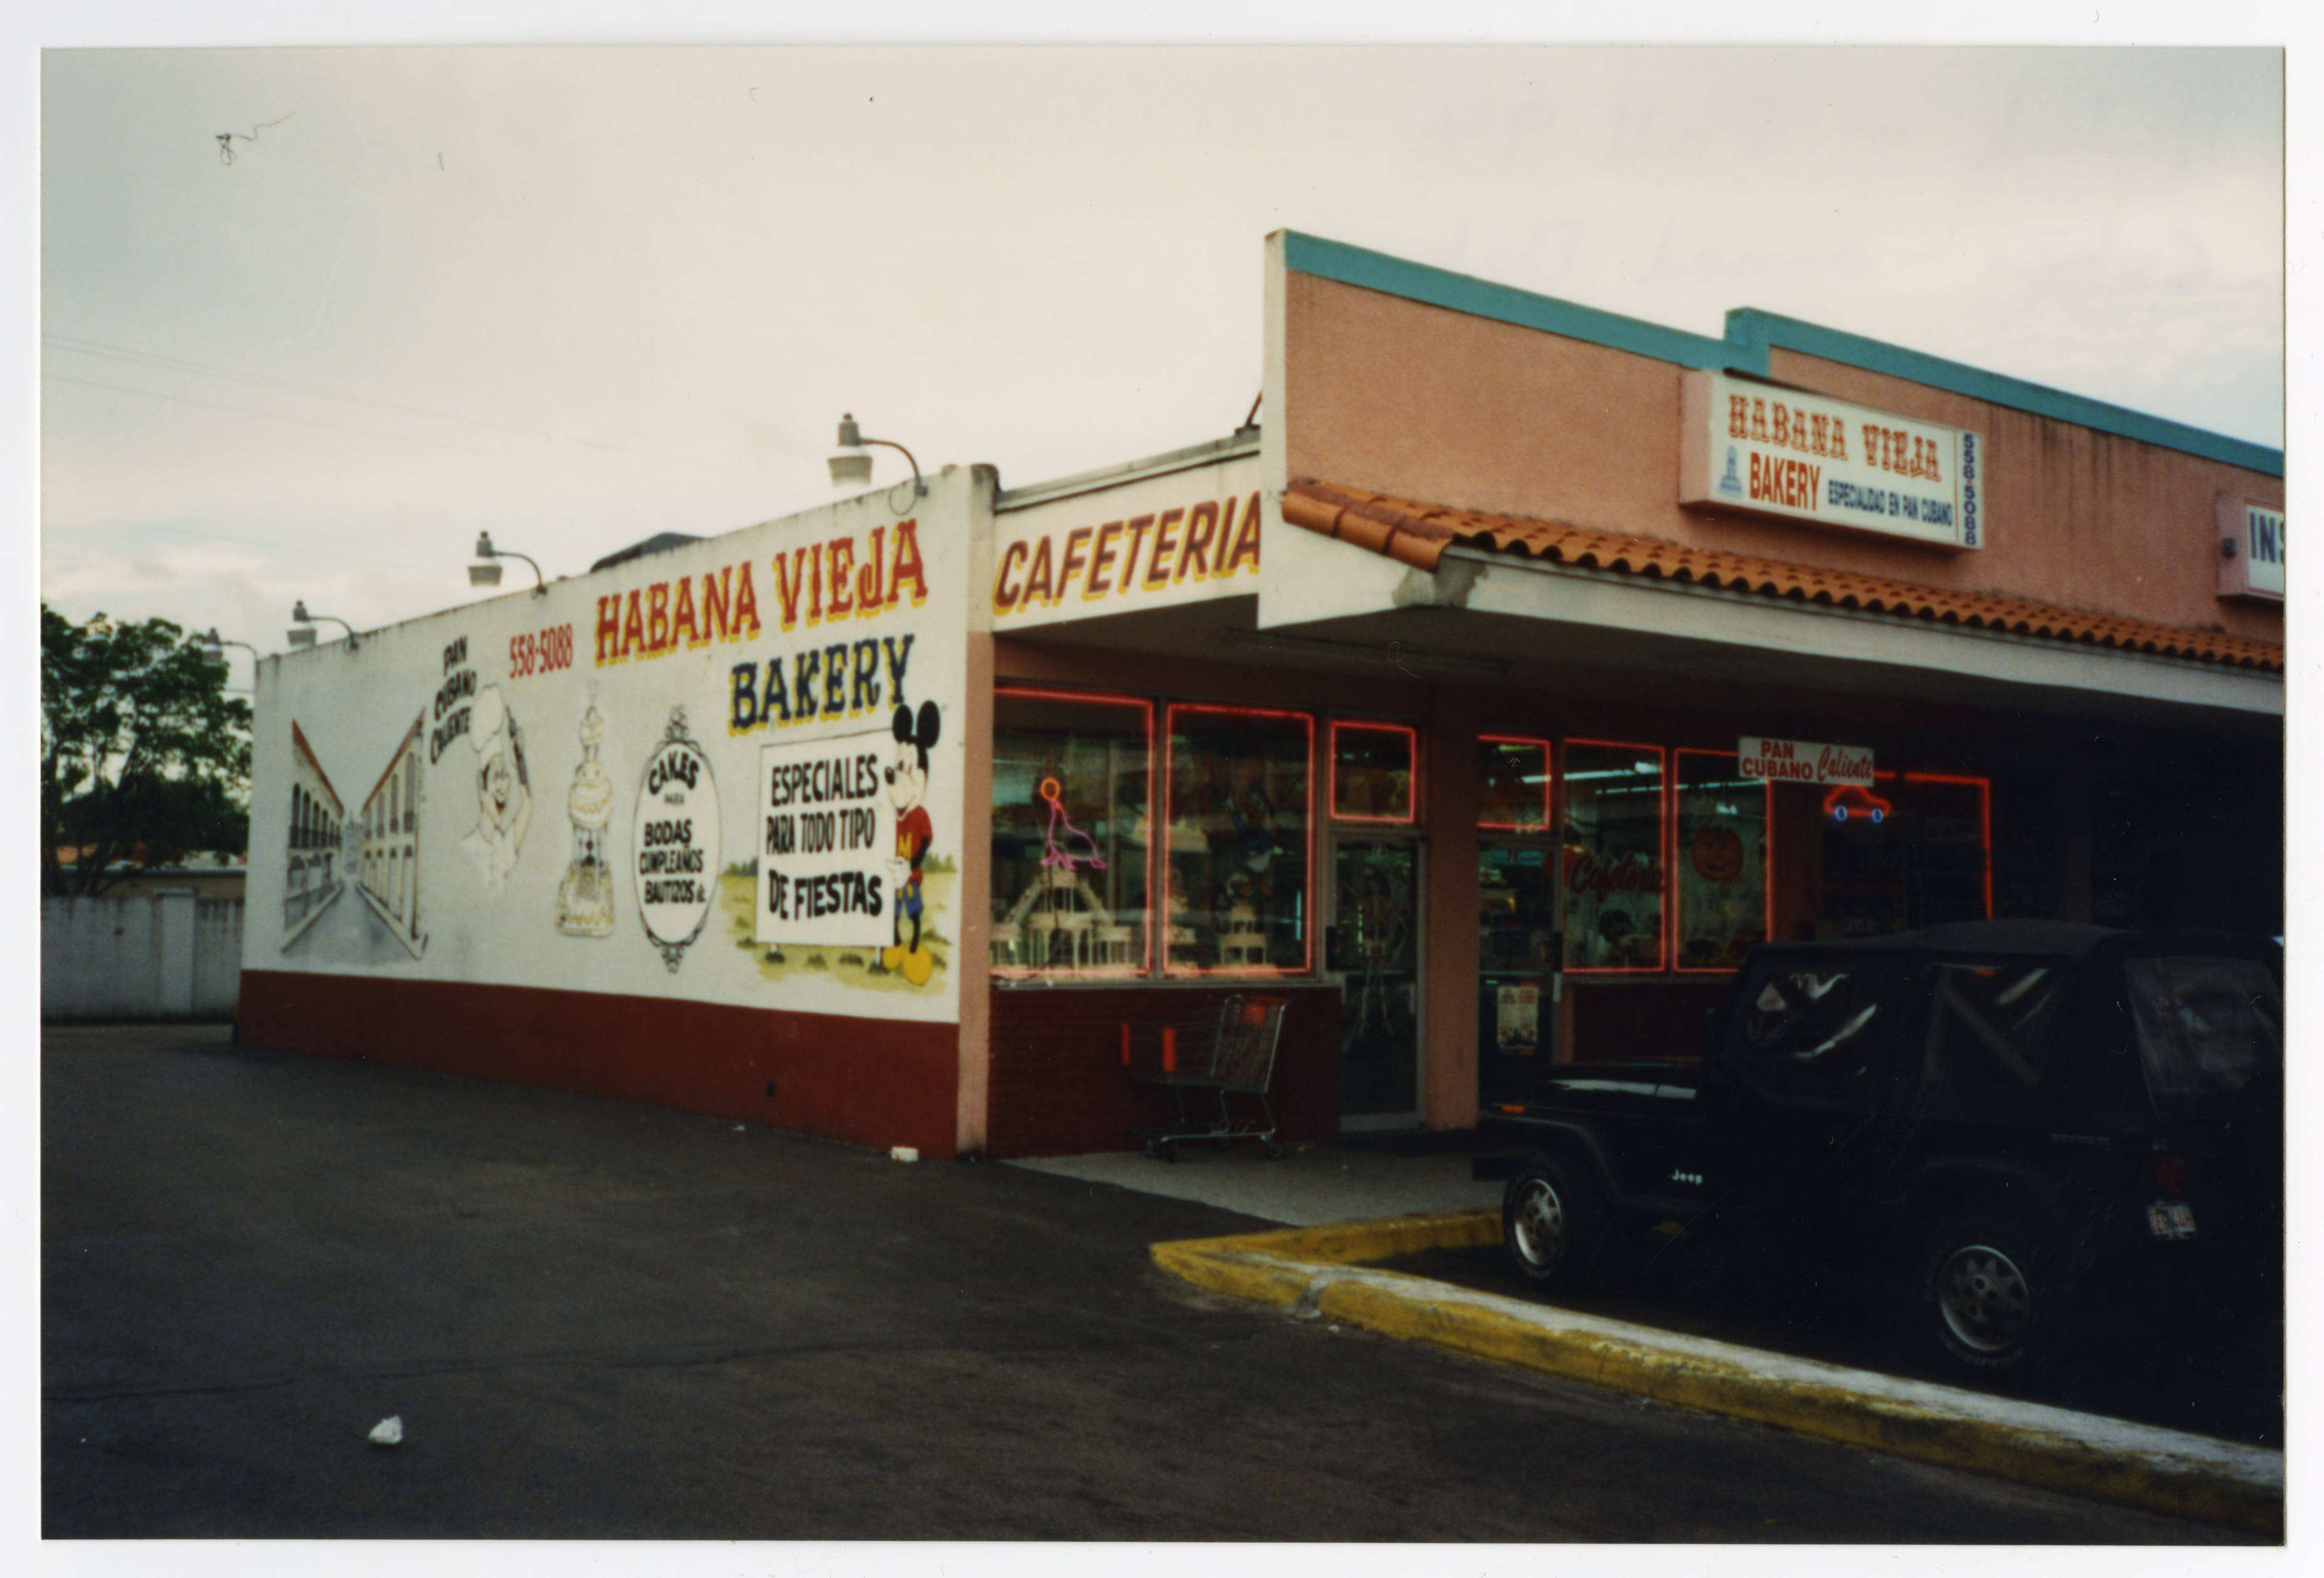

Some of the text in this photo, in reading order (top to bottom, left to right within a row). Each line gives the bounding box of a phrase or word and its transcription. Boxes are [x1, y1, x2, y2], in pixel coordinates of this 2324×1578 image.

[1729, 394, 1941, 482] HABANA VIEJA
[1750, 452, 1821, 510] BAKERY
[1903, 495, 1918, 520] PAN
[994, 491, 1260, 611] CAFETERIA
[594, 518, 928, 665] HABANA VIEJA
[443, 635, 468, 677] PAN
[510, 623, 572, 679] 558-5088
[729, 634, 915, 733] BAKERY
[649, 751, 699, 795] CAKES
[1742, 746, 1872, 781] CUBANO Caliente
[1761, 740, 1794, 759] PAN
[771, 753, 878, 807] ESPECIALES
[645, 818, 691, 847] BODAS
[766, 807, 875, 855] PARA TODO TIPO
[644, 879, 694, 904] BAUTIZOS
[769, 869, 882, 921] DE FIESTAS
[1672, 1168, 1703, 1186] Jeep
